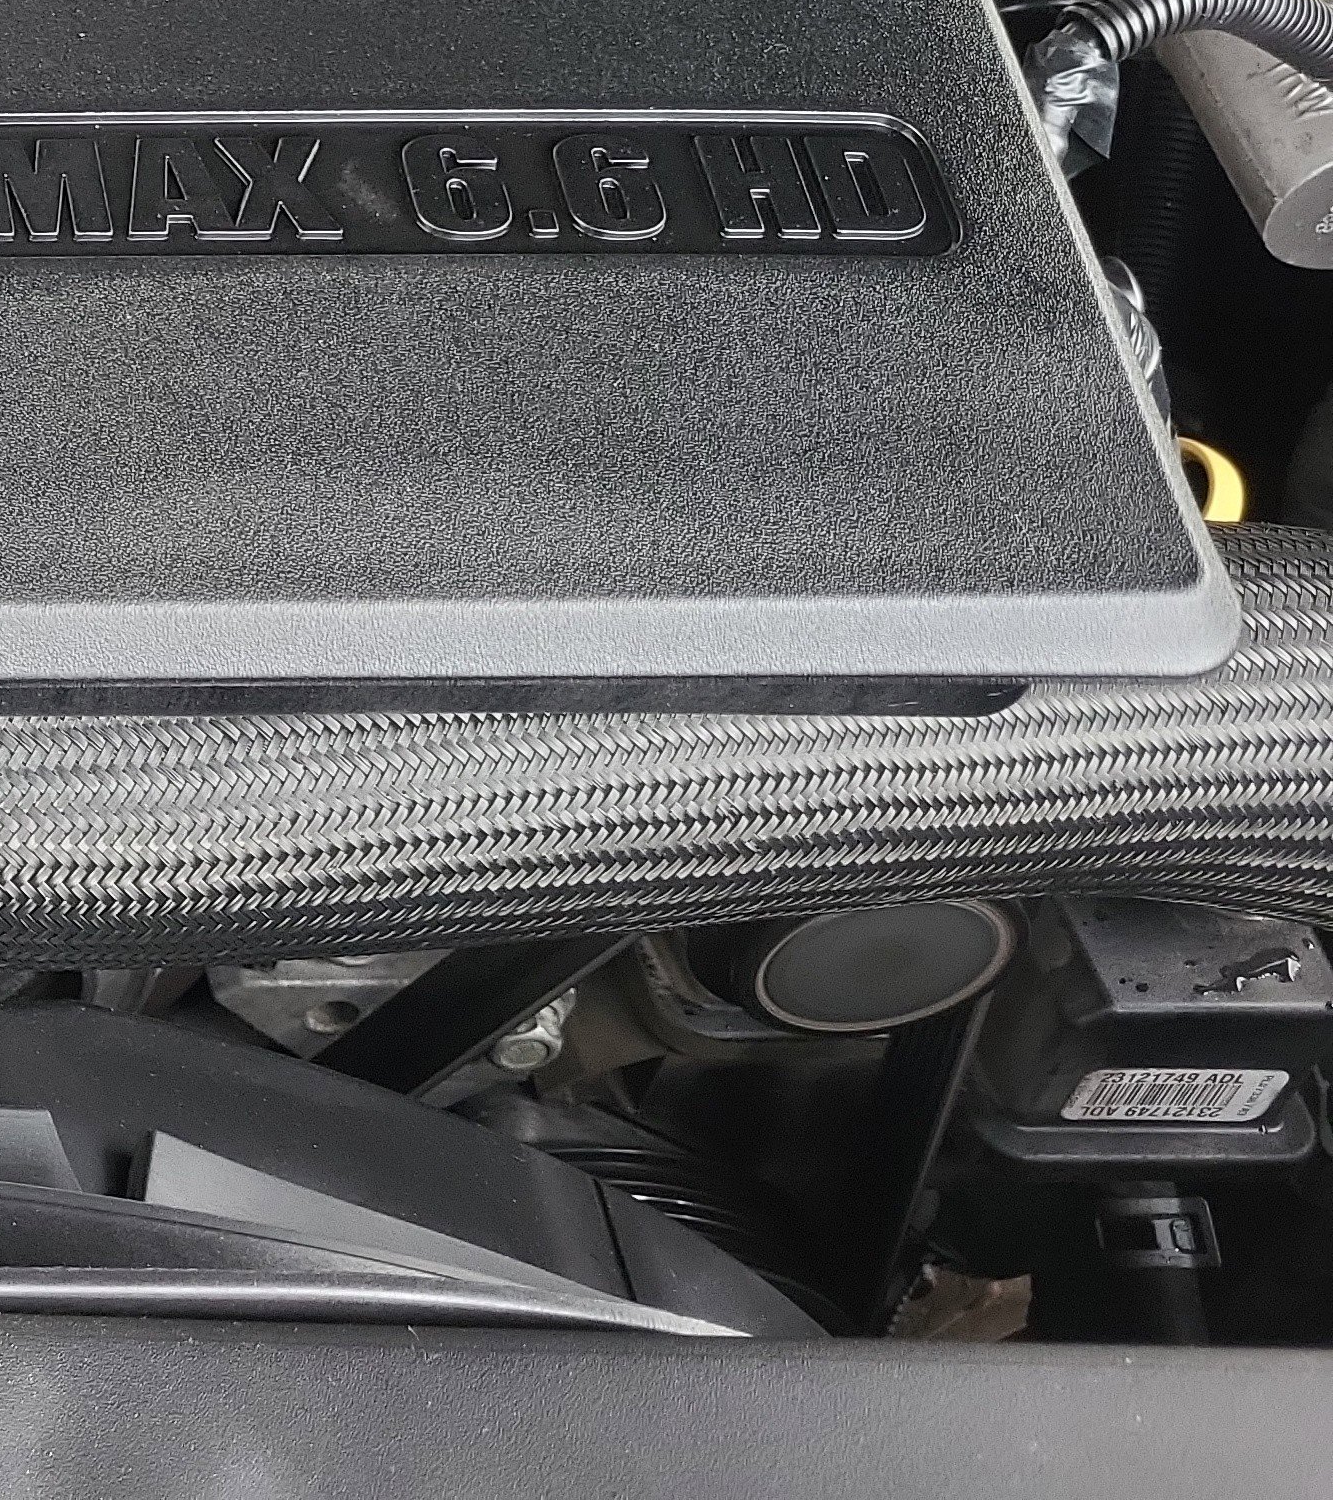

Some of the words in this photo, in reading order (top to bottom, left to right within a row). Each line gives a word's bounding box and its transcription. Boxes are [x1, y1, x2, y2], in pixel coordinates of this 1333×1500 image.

[401, 134, 668, 241] 6.6
[693, 134, 928, 240] HD
[1100, 1072, 1199, 1084] 23121749
[1205, 1073, 1244, 1085] ADL
[1124, 1106, 1223, 1117] 23121749
